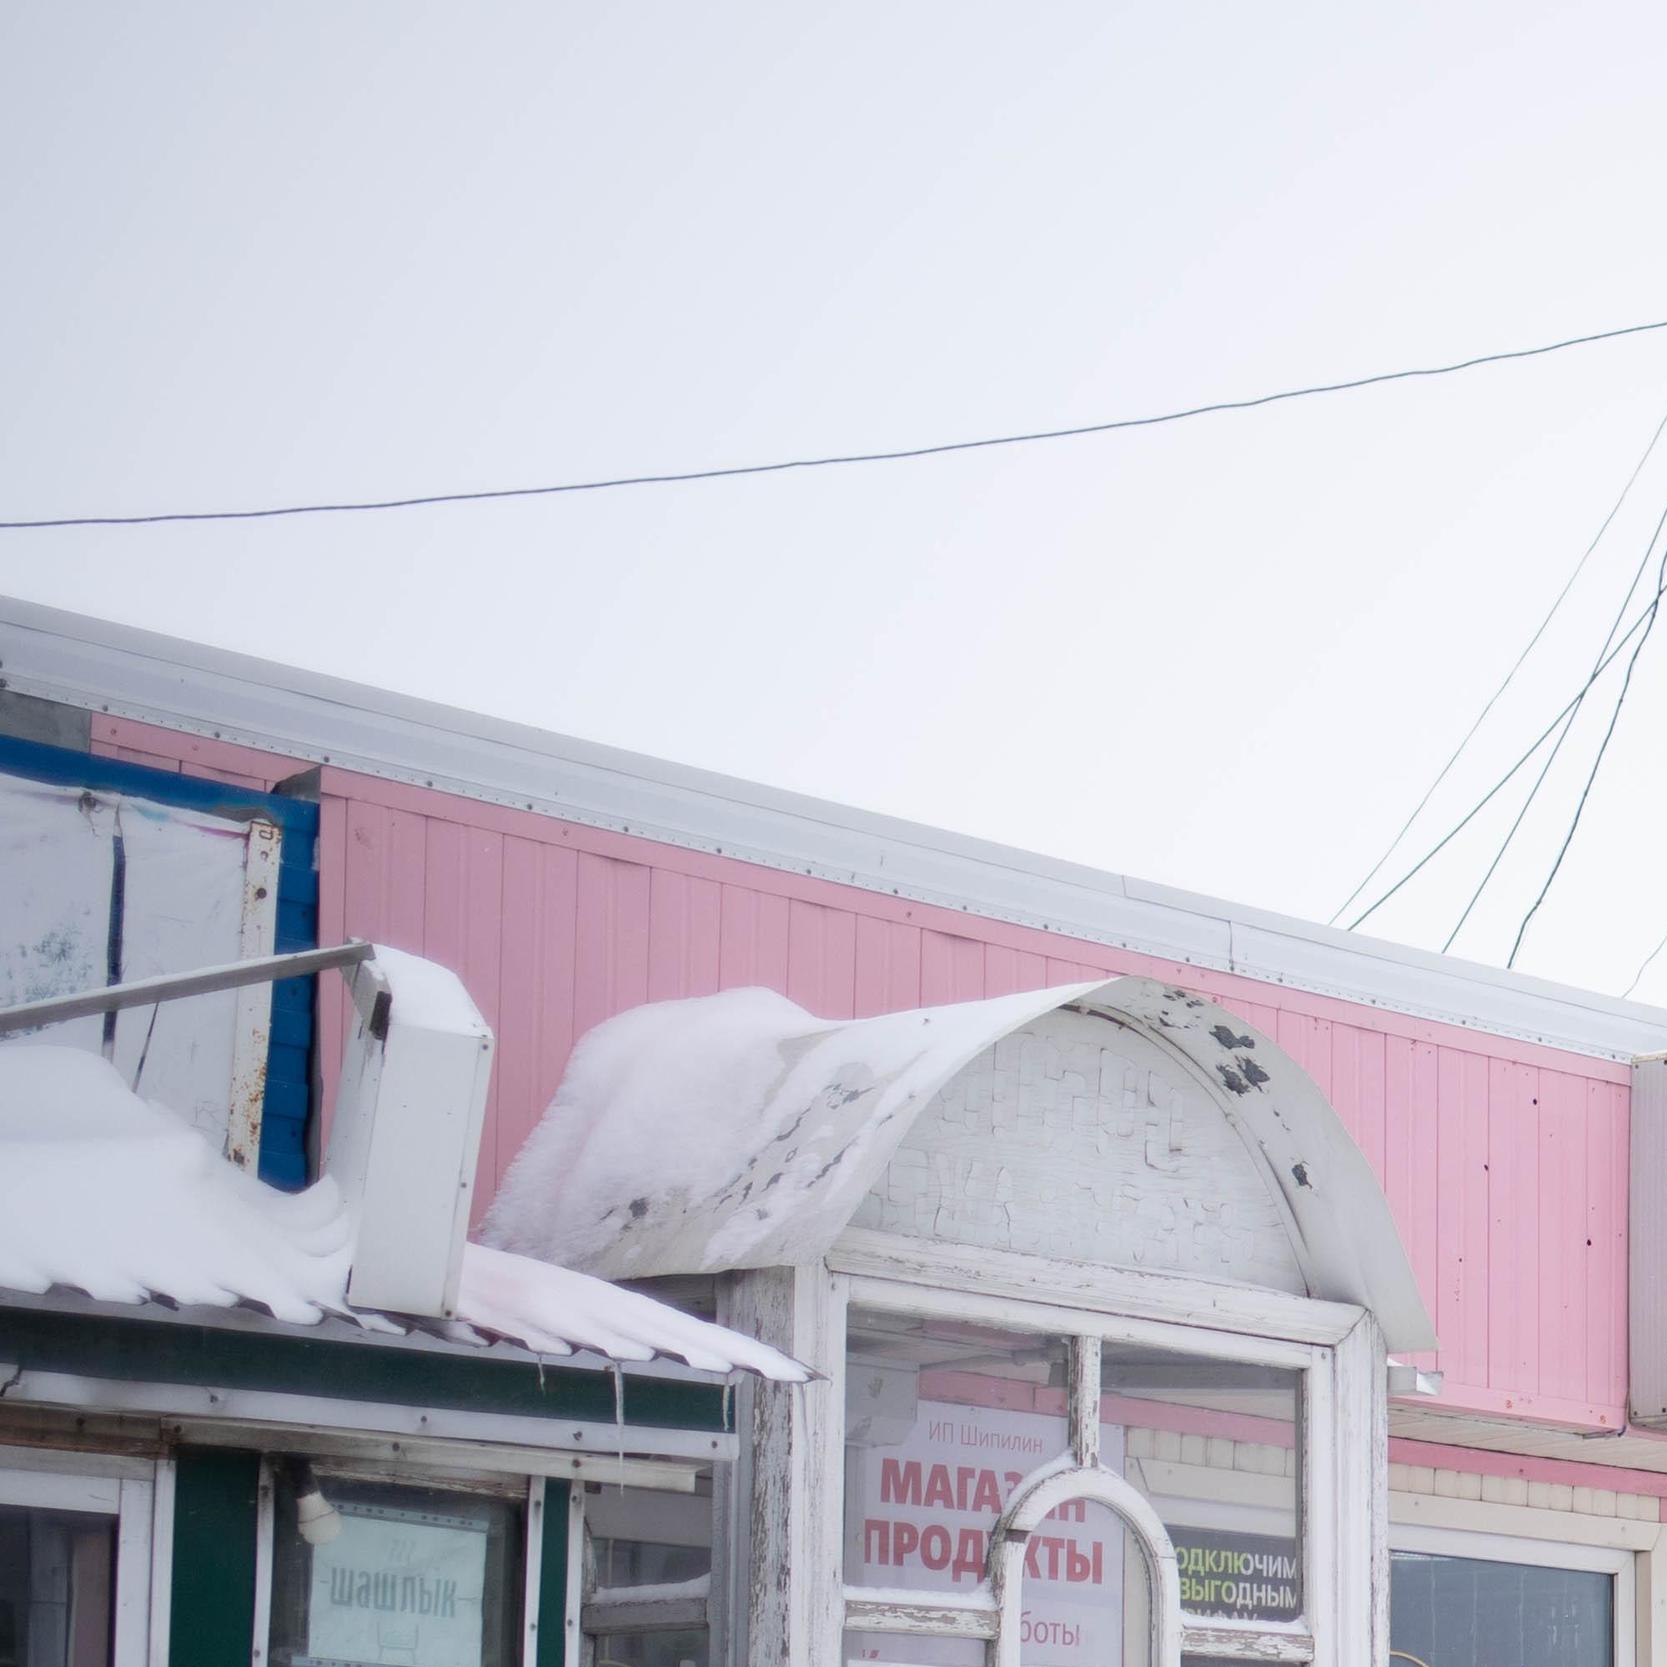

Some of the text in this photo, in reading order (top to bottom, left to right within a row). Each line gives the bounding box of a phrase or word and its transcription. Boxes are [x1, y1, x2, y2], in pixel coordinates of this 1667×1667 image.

[929, 1421, 1042, 1453] ИП Шипилин
[864, 1519, 1103, 1584] ПРОДКТЫ
[1175, 1546, 1297, 1580] ОДКЛЮЧИМ
